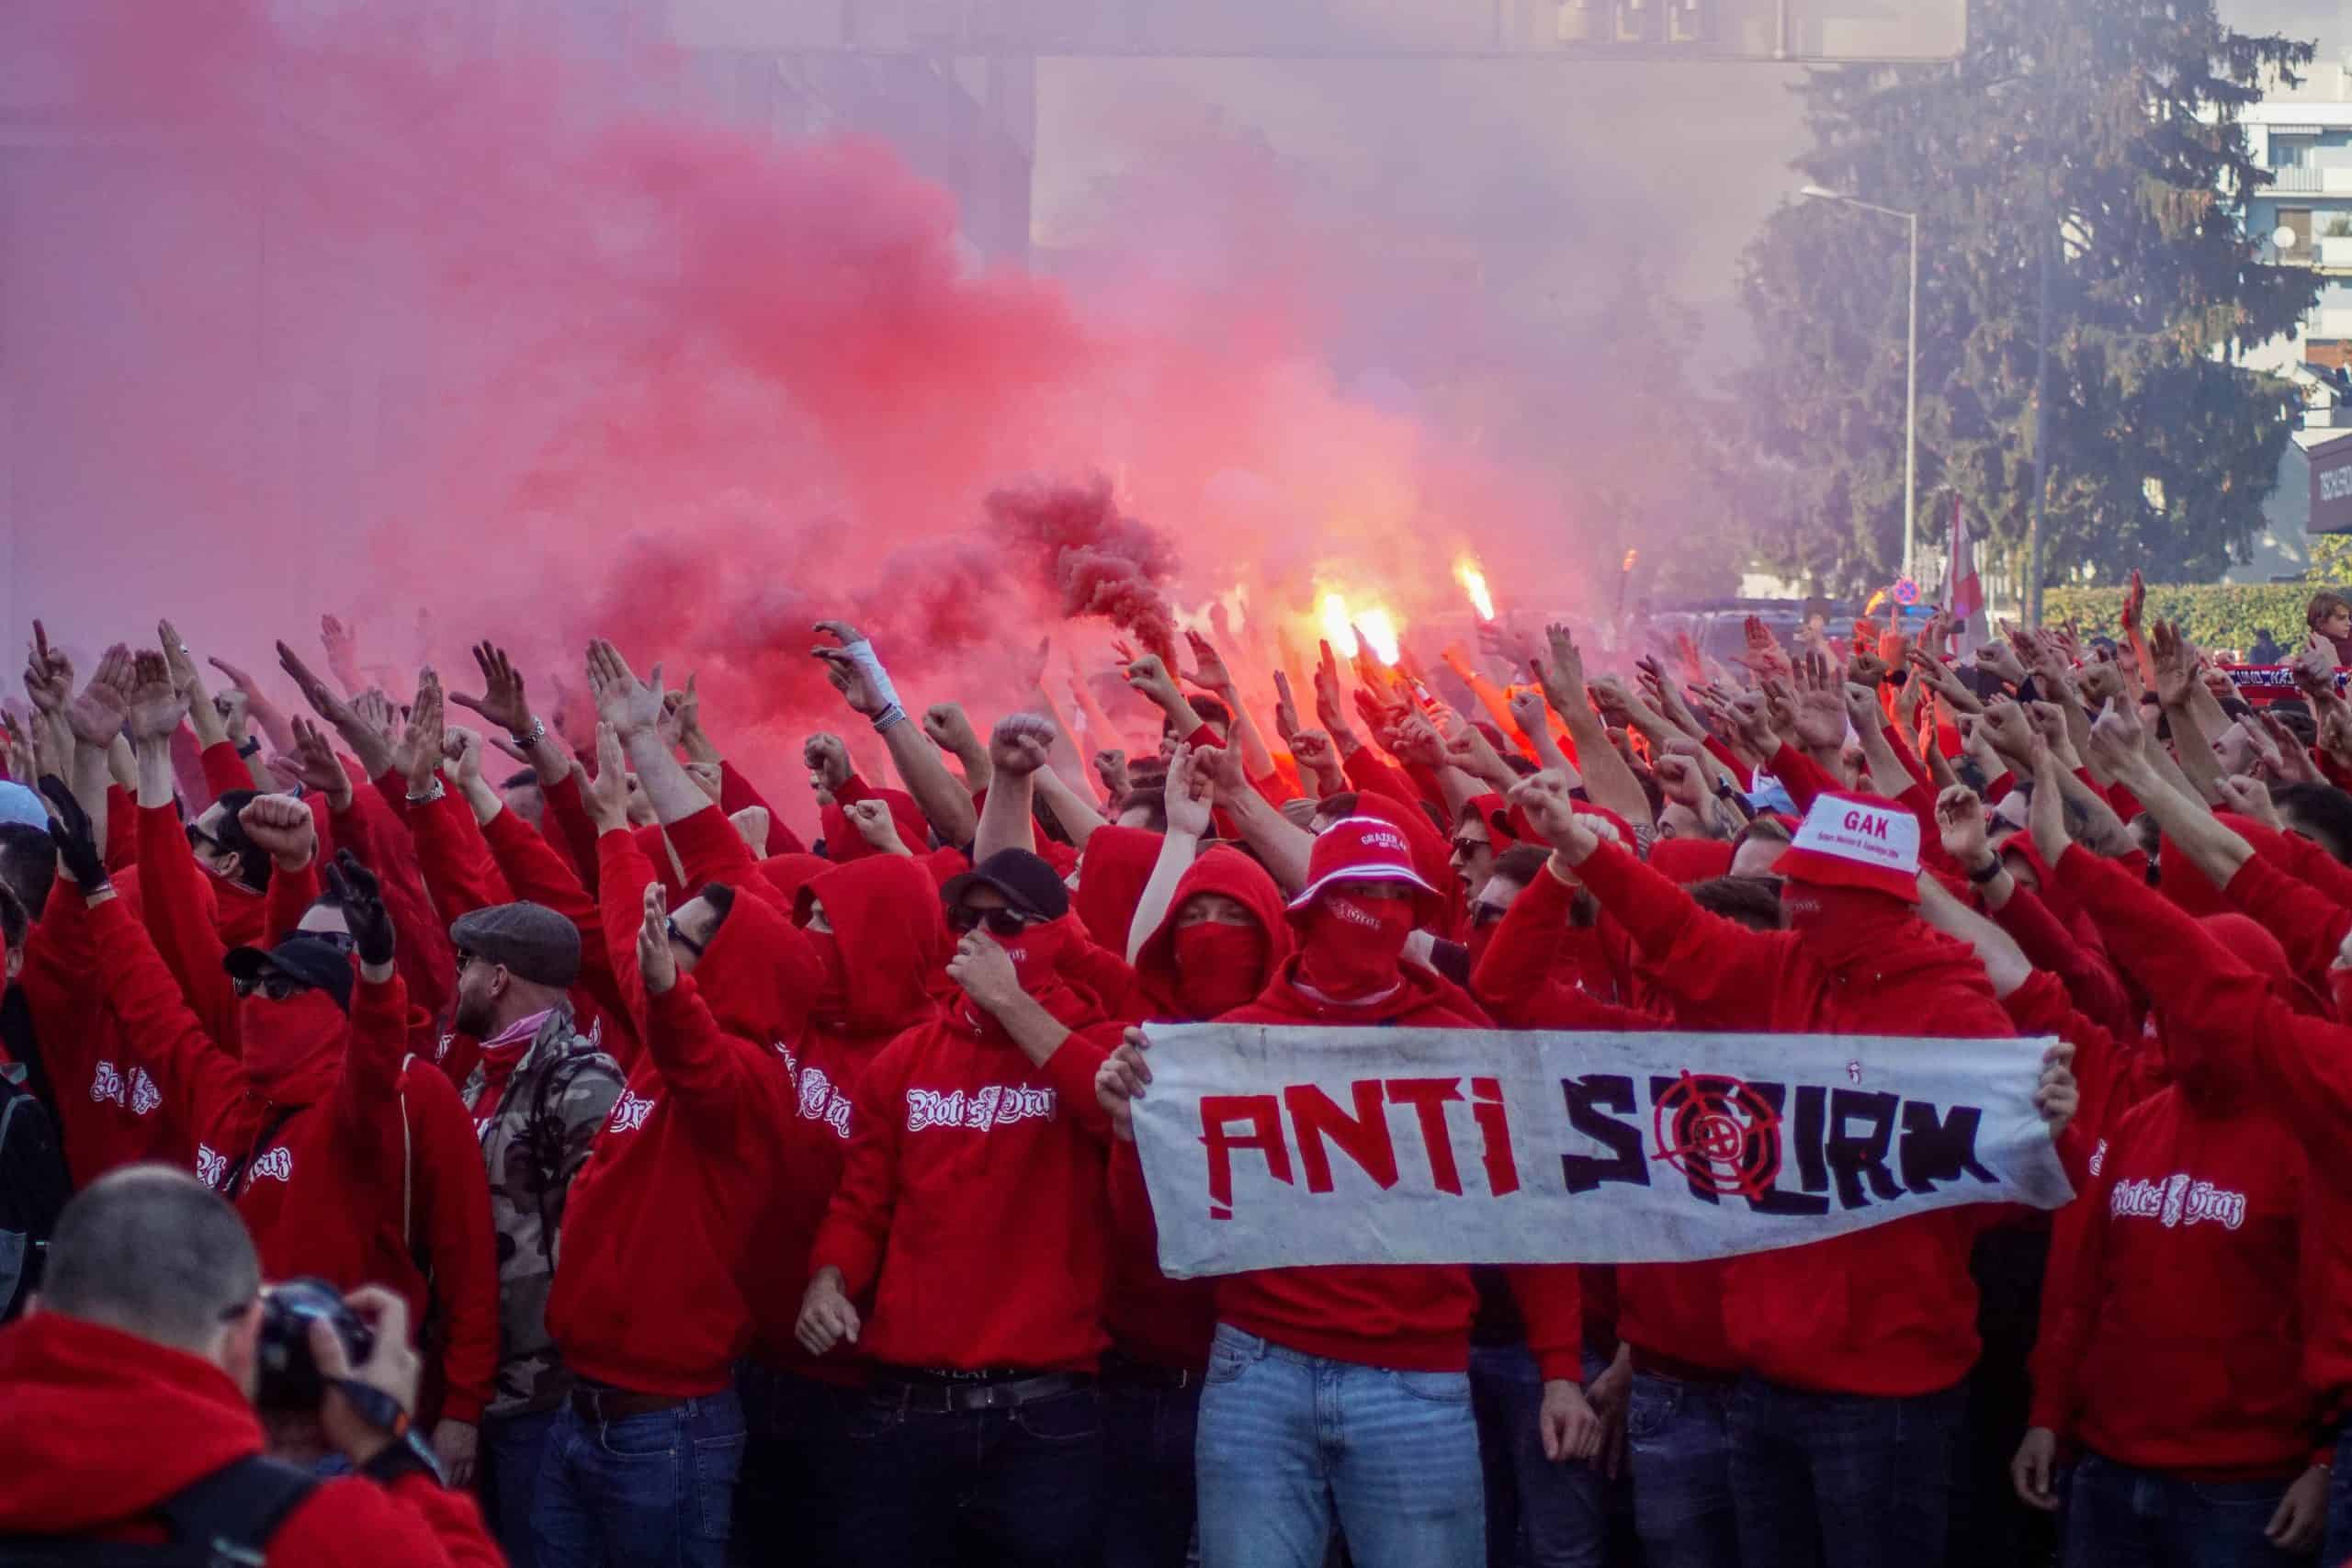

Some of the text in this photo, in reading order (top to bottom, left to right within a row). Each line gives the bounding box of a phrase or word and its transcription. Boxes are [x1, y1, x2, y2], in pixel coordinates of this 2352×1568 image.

[1844, 810, 1890, 840] GAK
[995, 1082, 1057, 1123] Gra
[1561, 1074, 2001, 1215] STURM
